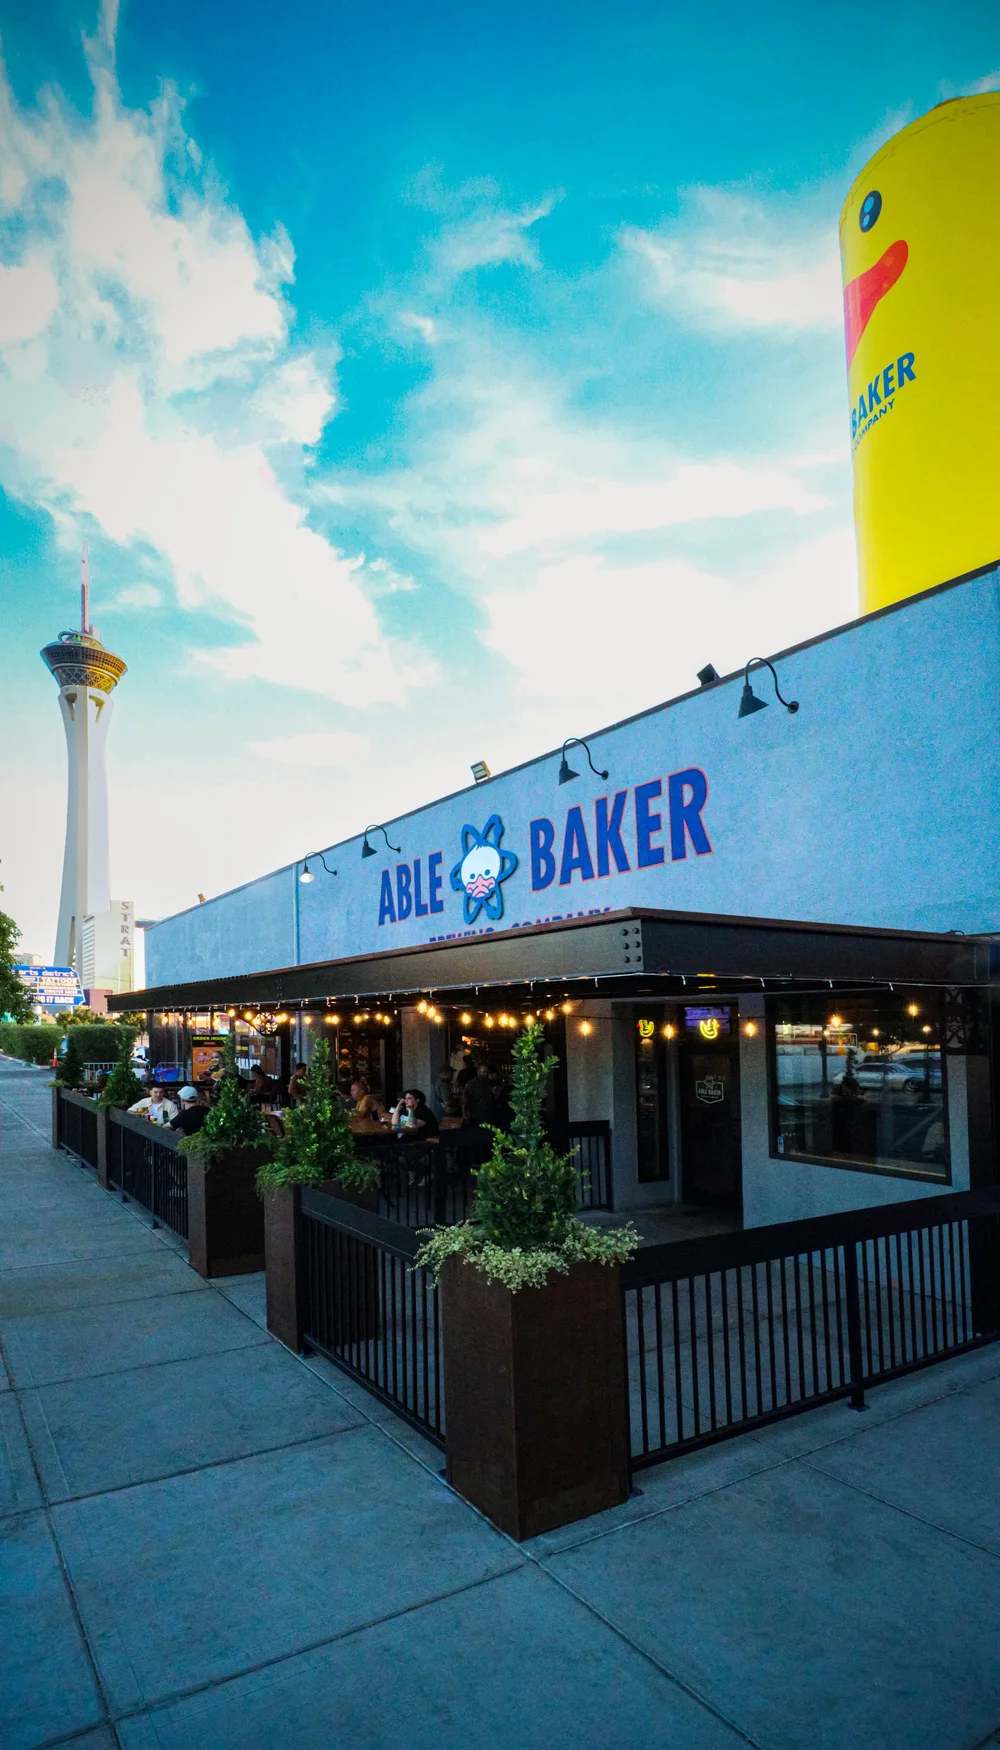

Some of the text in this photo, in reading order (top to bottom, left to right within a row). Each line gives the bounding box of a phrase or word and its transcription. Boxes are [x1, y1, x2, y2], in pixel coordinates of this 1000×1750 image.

[851, 352, 916, 440] BAKER
[378, 766, 715, 927] ABLE BAKER
[120, 901, 131, 957] STRAT
